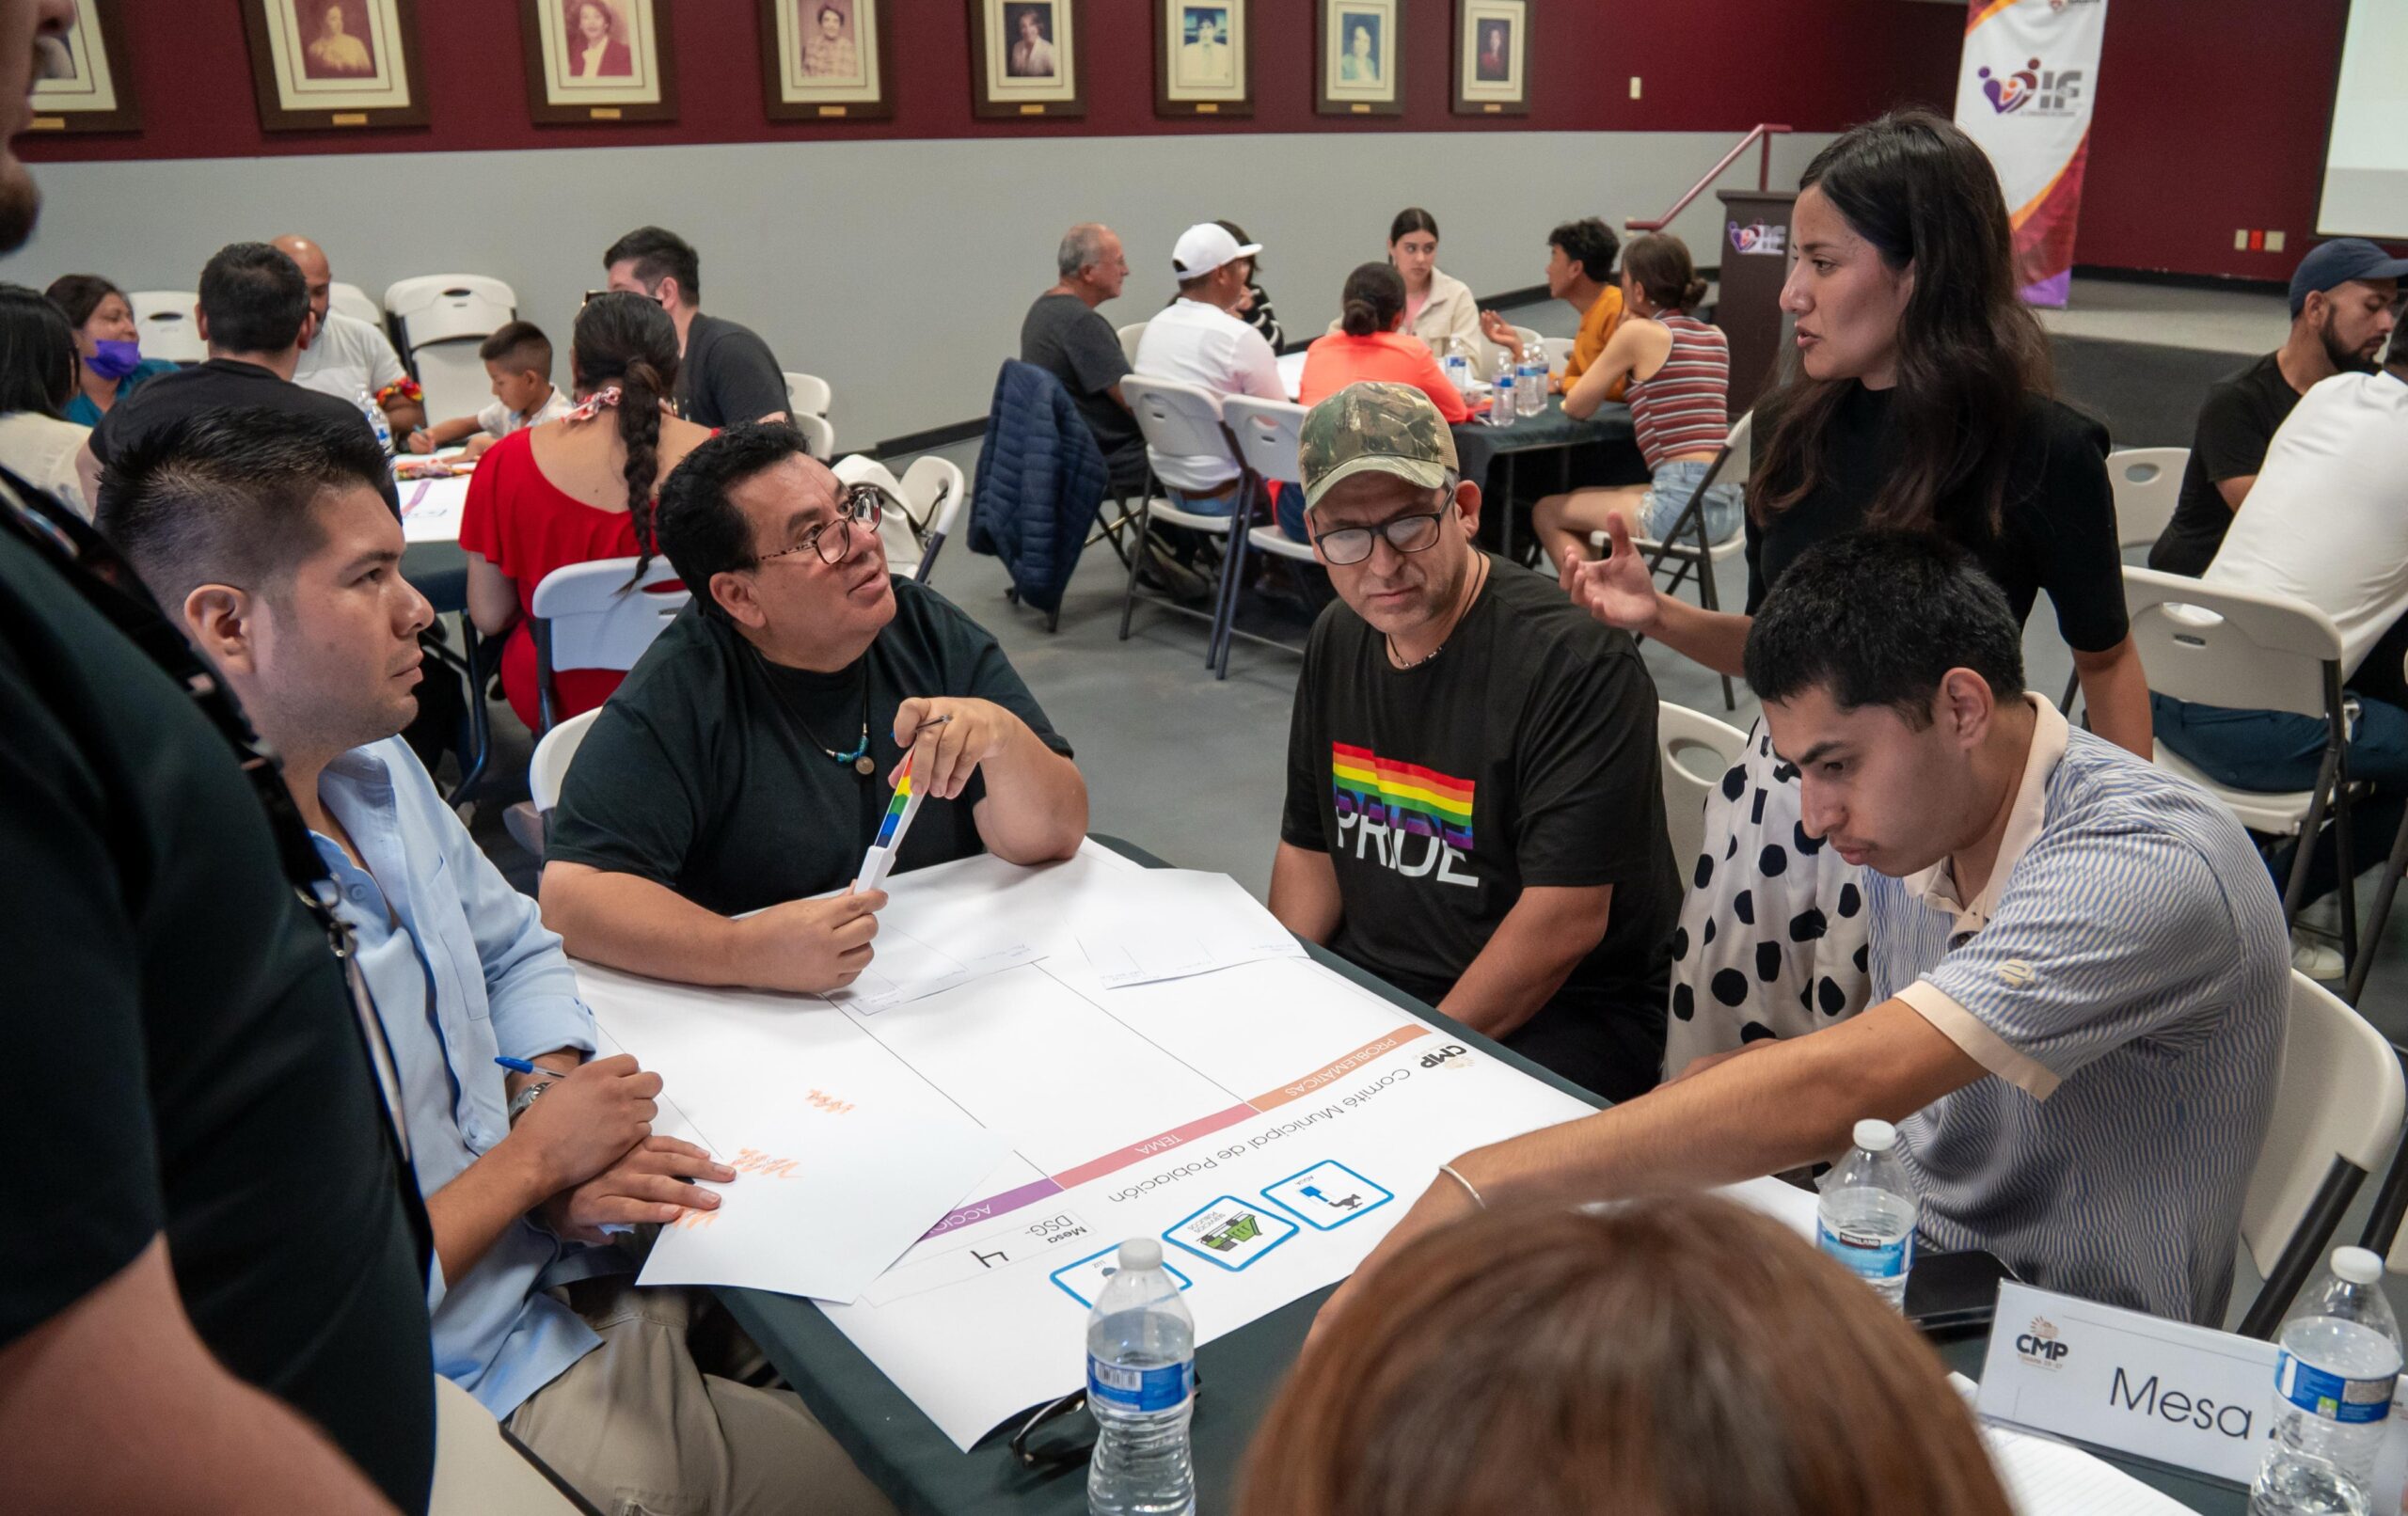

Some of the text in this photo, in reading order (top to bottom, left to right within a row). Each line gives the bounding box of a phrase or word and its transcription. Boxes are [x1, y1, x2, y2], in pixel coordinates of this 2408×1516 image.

[1334, 788, 1480, 889] PRIDE
[1285, 1038, 1398, 1097] PROBLEMÁTICAS
[1420, 1045, 1467, 1069] CMP
[1108, 1068, 1411, 1203] Comité Municipal de Población
[1134, 1134, 1183, 1155] TEMA
[931, 1204, 991, 1234] ACCIO
[1047, 1226, 1087, 1244] Mesa
[970, 1250, 1009, 1269] 4
[2016, 1334, 2068, 1361] CMP
[2109, 1366, 2254, 1440] Mesa
